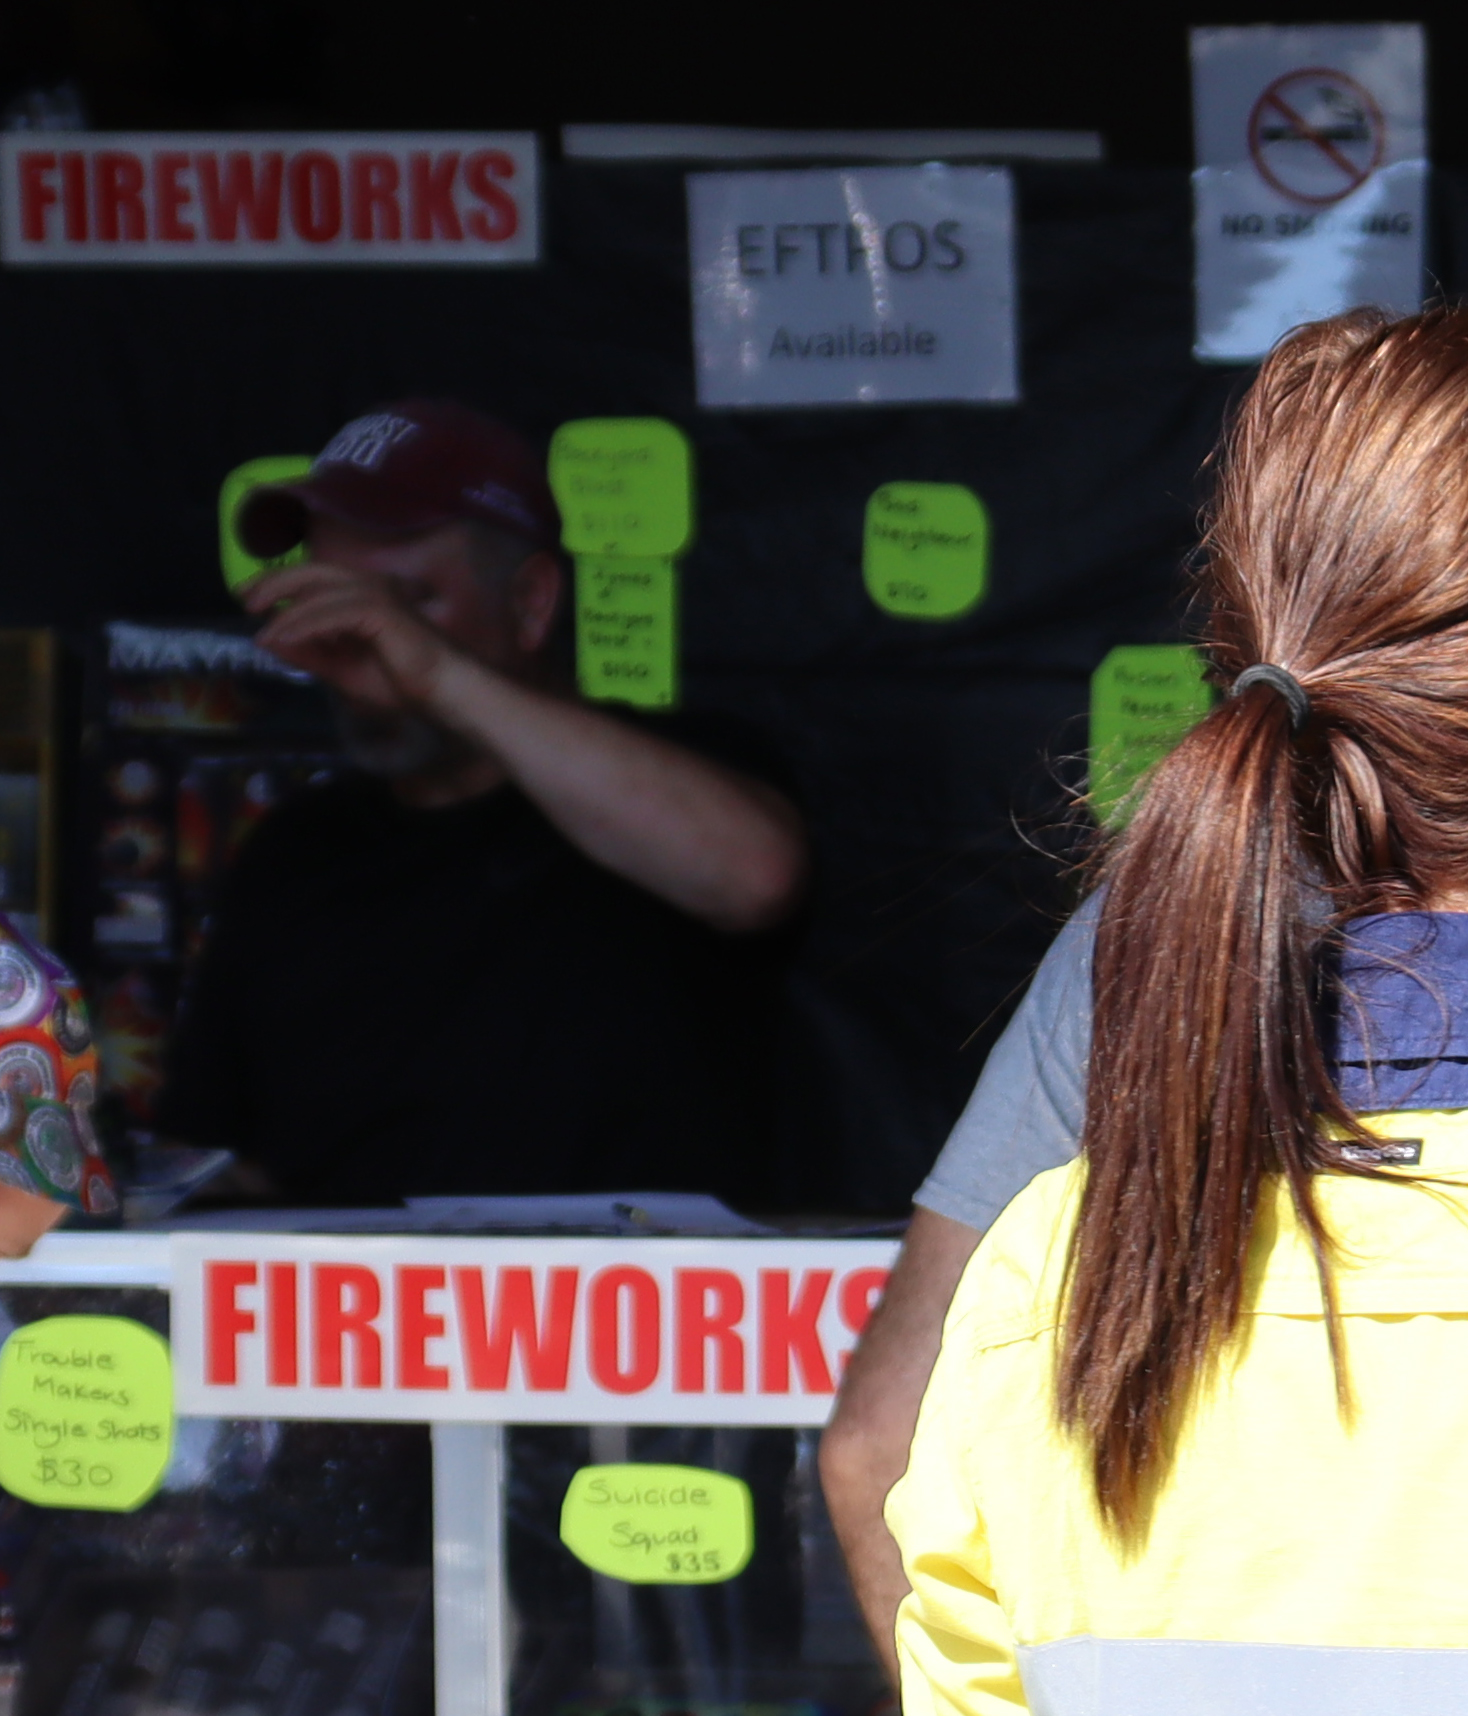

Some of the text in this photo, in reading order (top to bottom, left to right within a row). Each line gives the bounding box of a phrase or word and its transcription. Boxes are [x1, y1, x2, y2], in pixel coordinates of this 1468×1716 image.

[16, 149, 520, 246] FIREWORKS
[1220, 213, 1264, 236] NO
[768, 323, 939, 358] Available
[12, 1339, 115, 1370] Trouble
[33, 1374, 130, 1407] Makers
[4, 1407, 88, 1449] Single
[31, 1456, 114, 1487] $30
[583, 1478, 713, 1507] Suicide
[609, 1520, 699, 1555] Squad
[664, 1550, 720, 1573] $35
